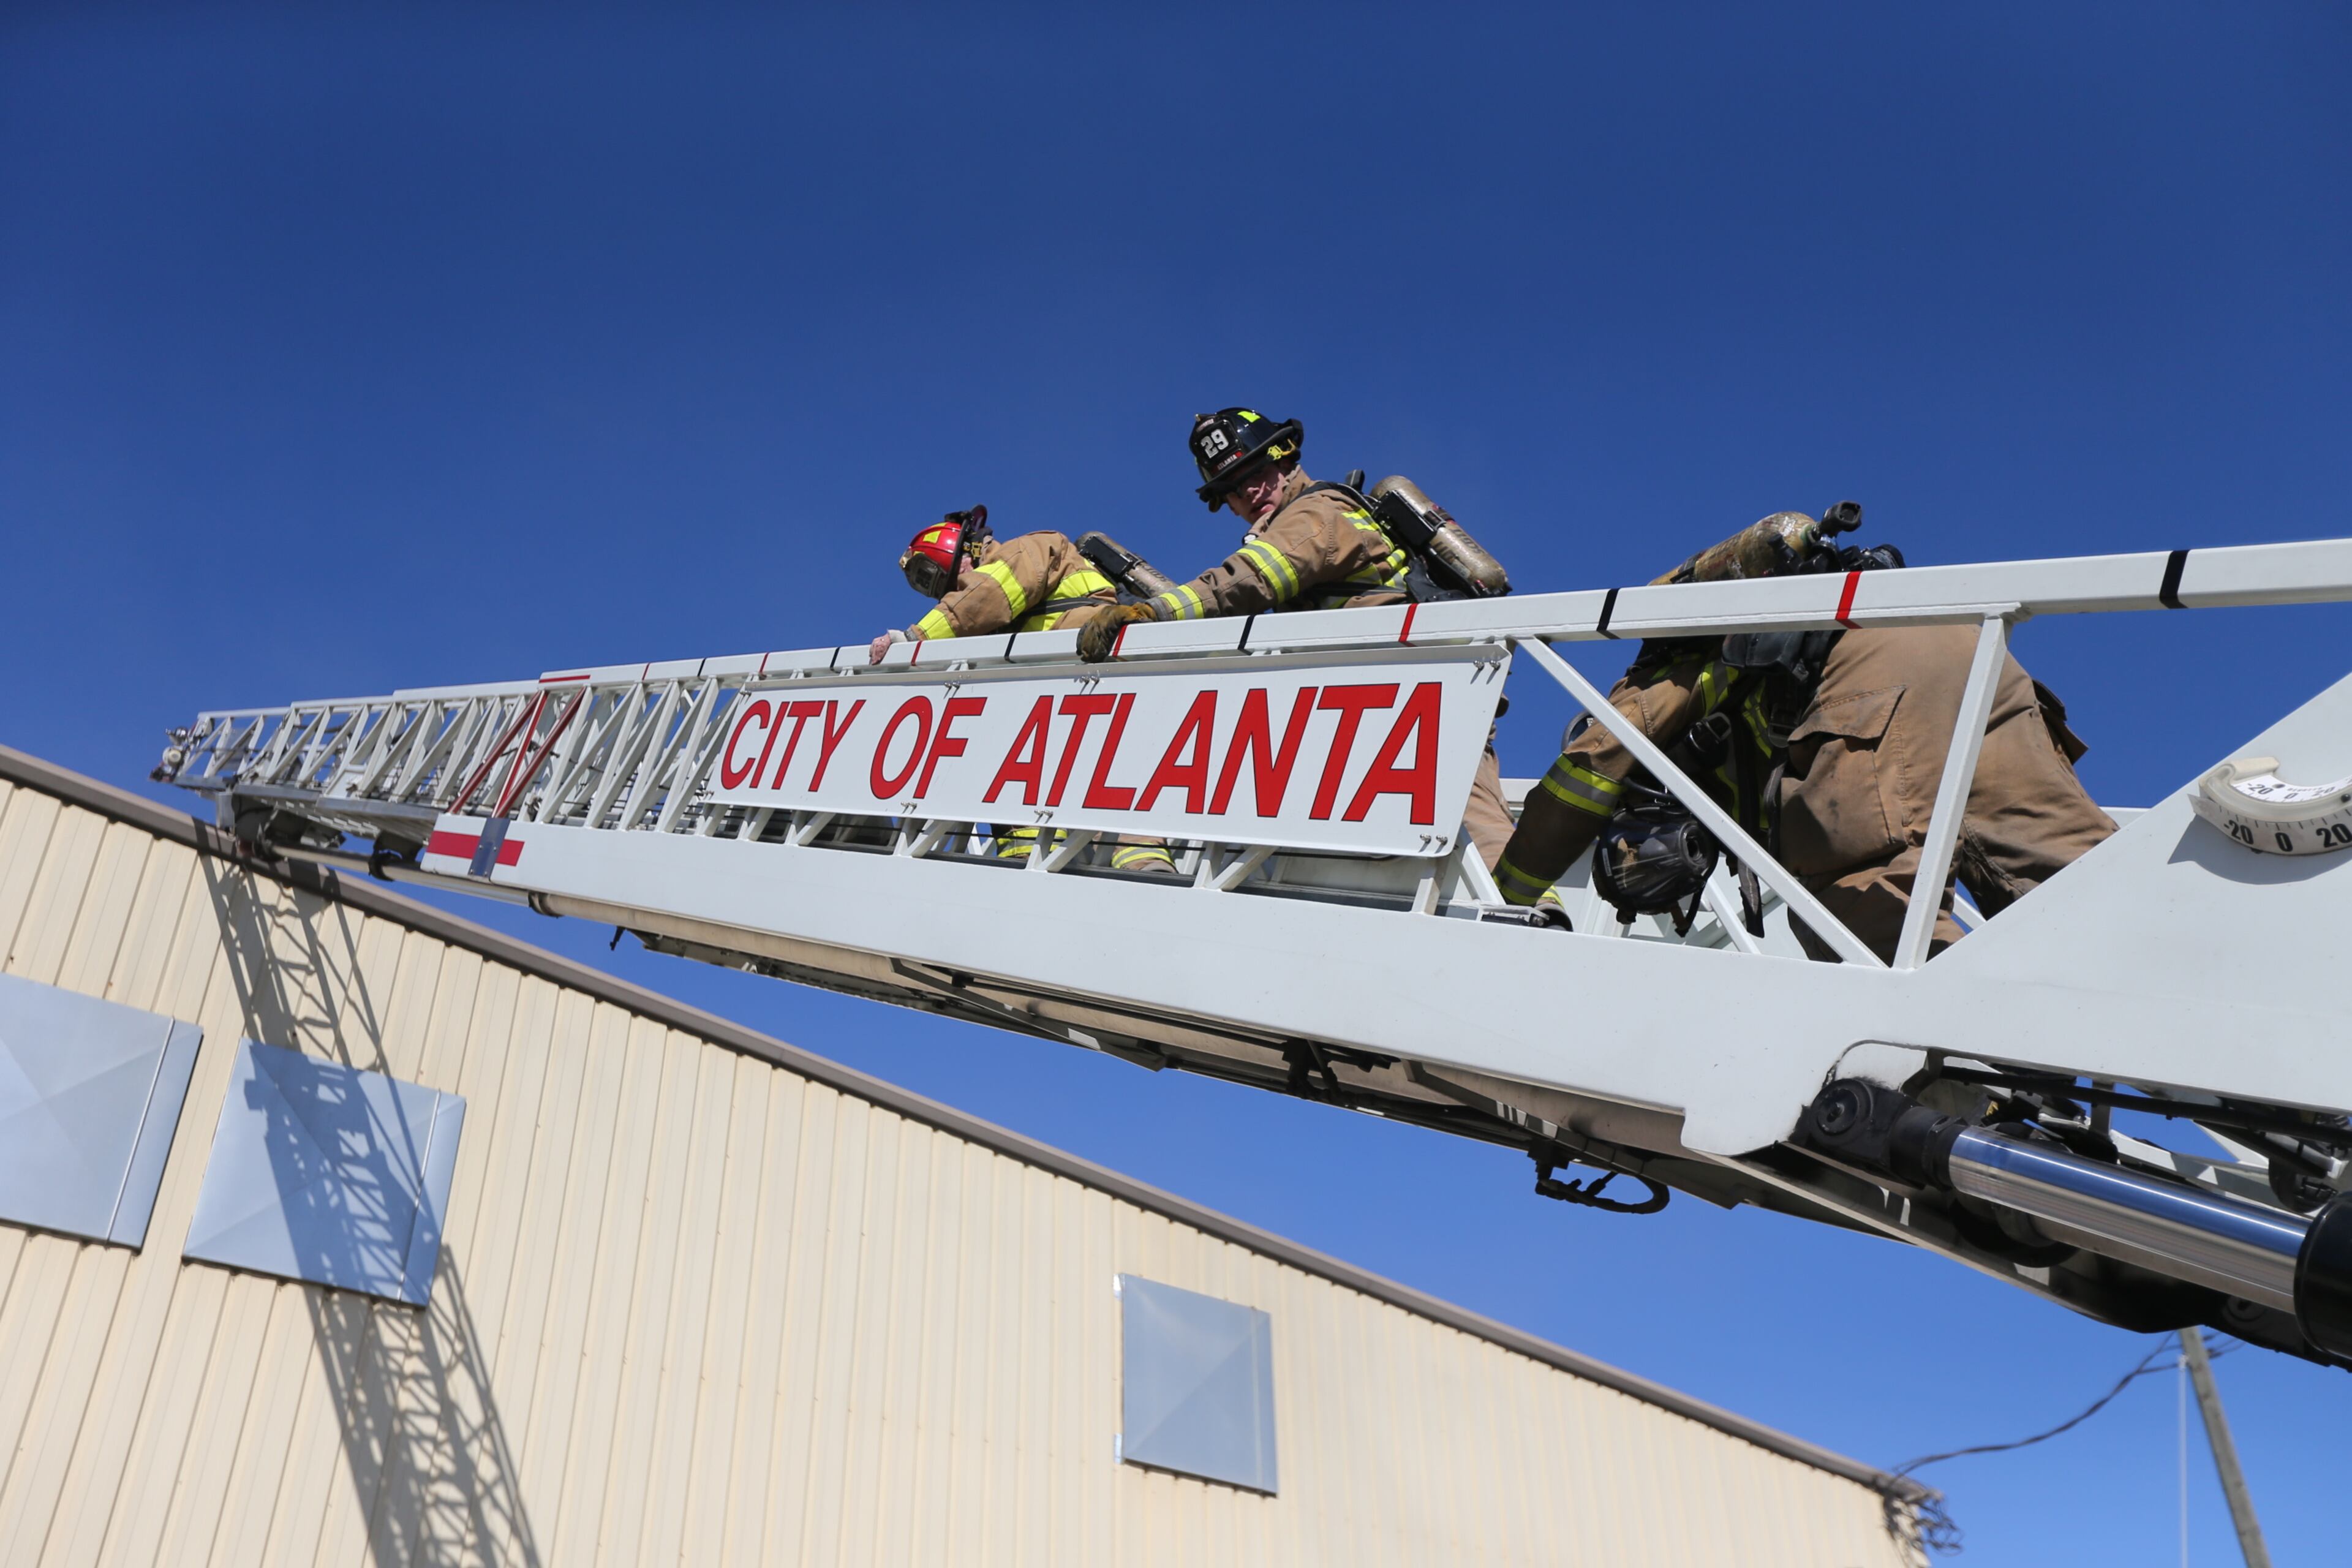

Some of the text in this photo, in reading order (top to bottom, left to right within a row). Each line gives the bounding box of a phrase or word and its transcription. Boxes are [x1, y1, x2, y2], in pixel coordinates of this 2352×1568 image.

[1200, 429, 1229, 459] 29
[1218, 454, 1237, 470] ATLANTA
[721, 682, 1442, 826] CITY OF ATLANTA
[2247, 783, 2274, 795] -20
[2312, 786, 2335, 797] 20
[2223, 820, 2352, 852] -20 0 20
